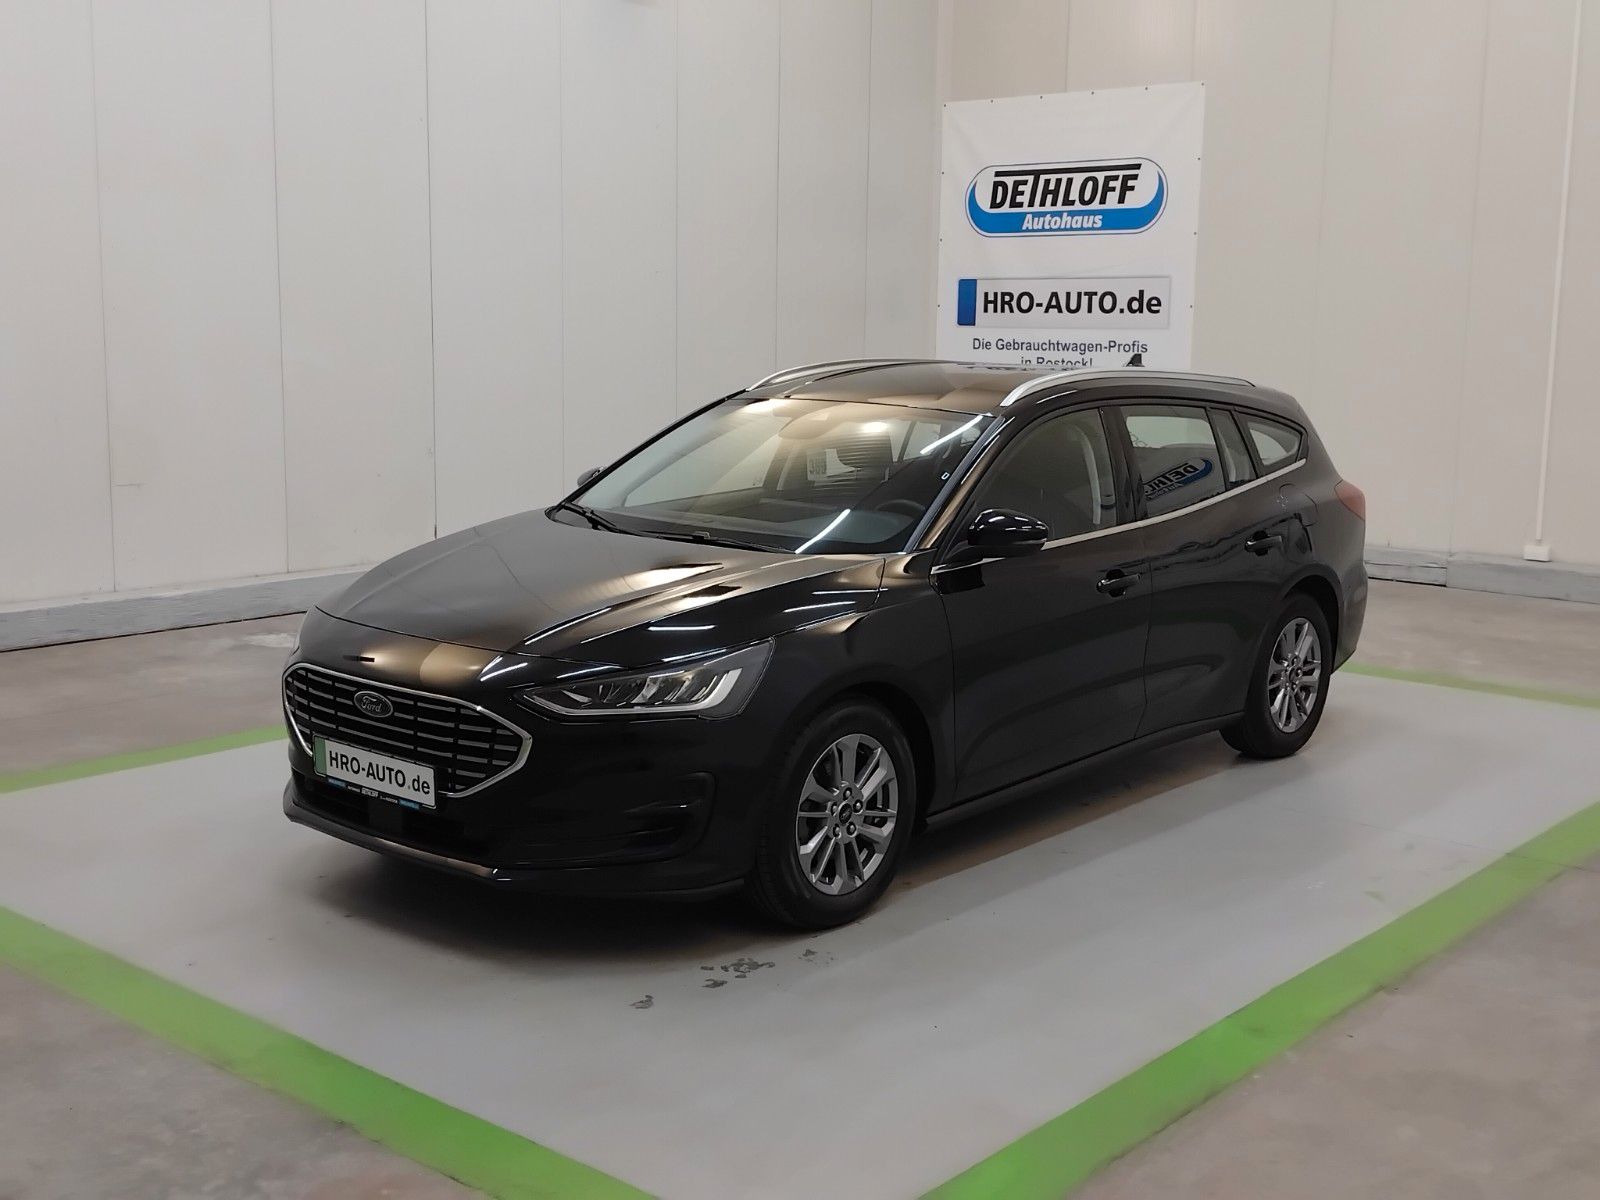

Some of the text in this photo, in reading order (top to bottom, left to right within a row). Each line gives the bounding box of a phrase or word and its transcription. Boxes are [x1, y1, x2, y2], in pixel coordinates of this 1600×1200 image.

[989, 163, 1142, 209] DETHLOFF
[1022, 213, 1103, 230] Autohaus
[983, 290, 1162, 314] HRO-AUTO.de
[972, 338, 1148, 355] Die Gebrauchtwagen-Profis
[1021, 357, 1032, 366] in
[361, 695, 382, 712] Ford
[329, 750, 431, 796] HRO-AUTO.de
